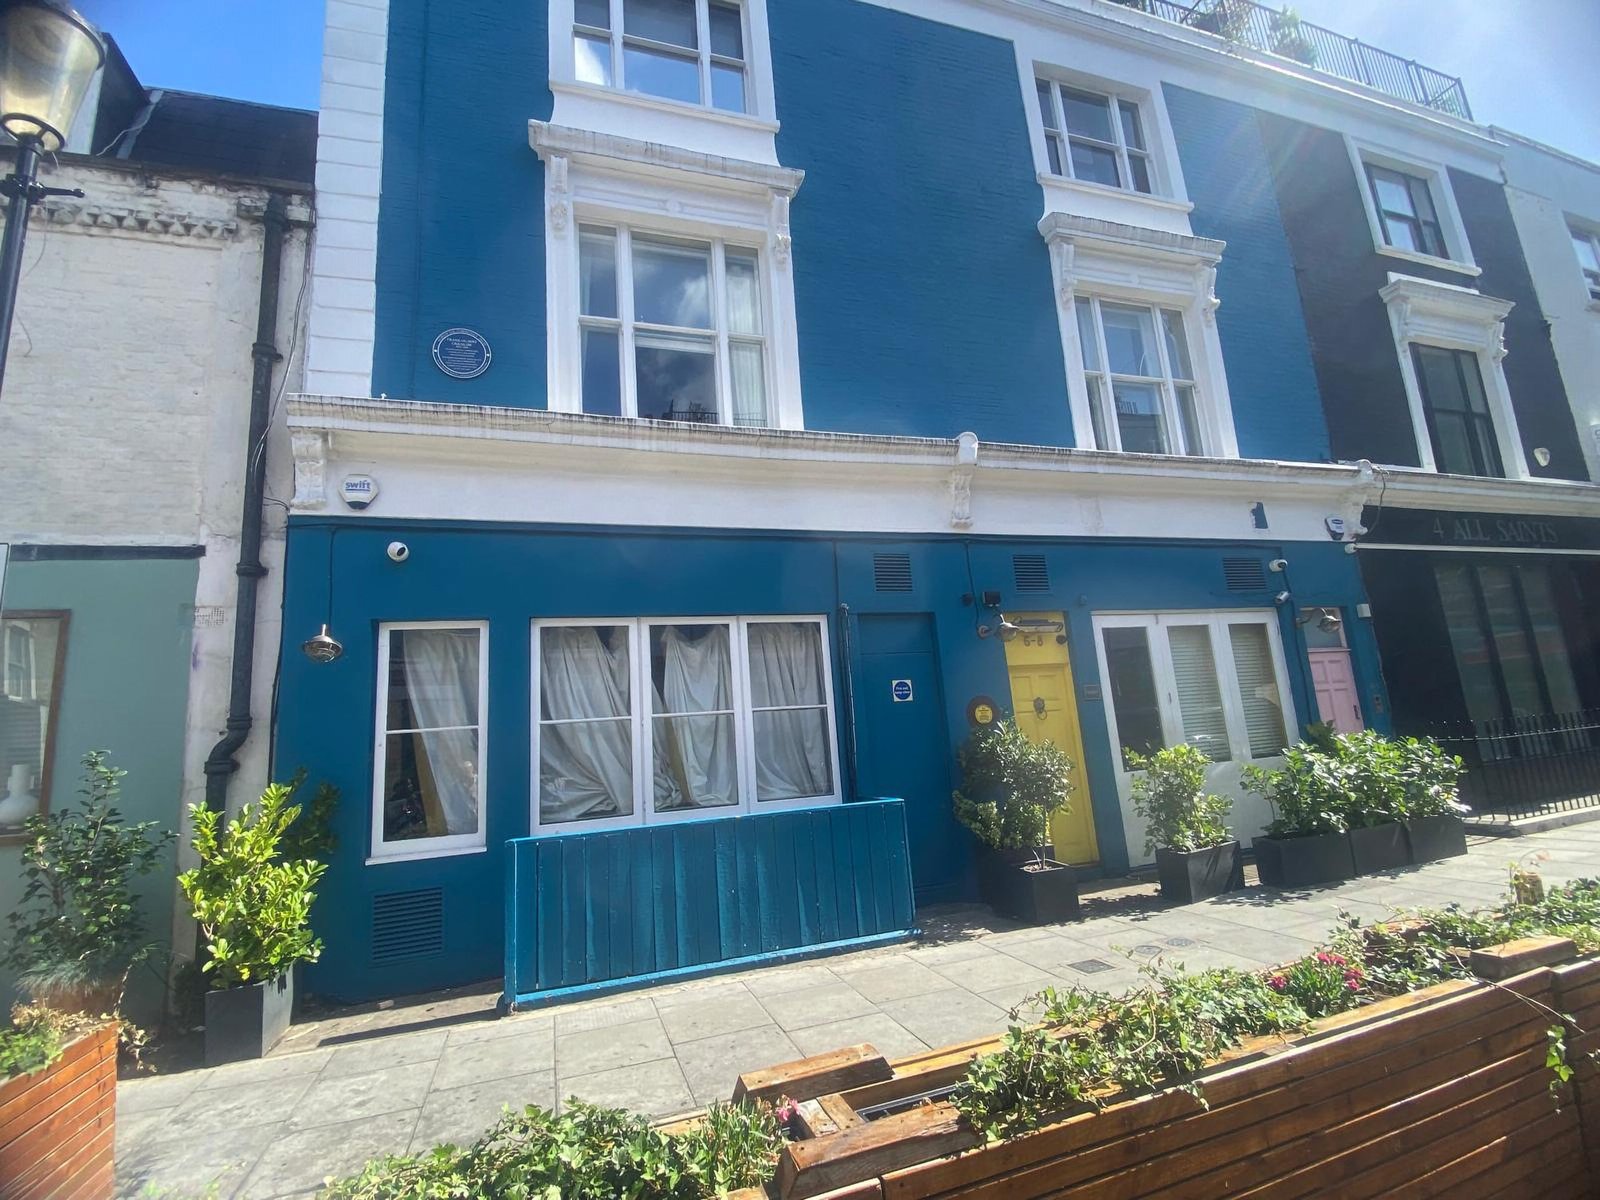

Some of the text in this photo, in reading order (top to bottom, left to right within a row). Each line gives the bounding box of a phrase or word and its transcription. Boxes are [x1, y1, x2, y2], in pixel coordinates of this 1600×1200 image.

[345, 480, 370, 489] swift
[1432, 517, 1559, 543] 4 ALL SAINTS
